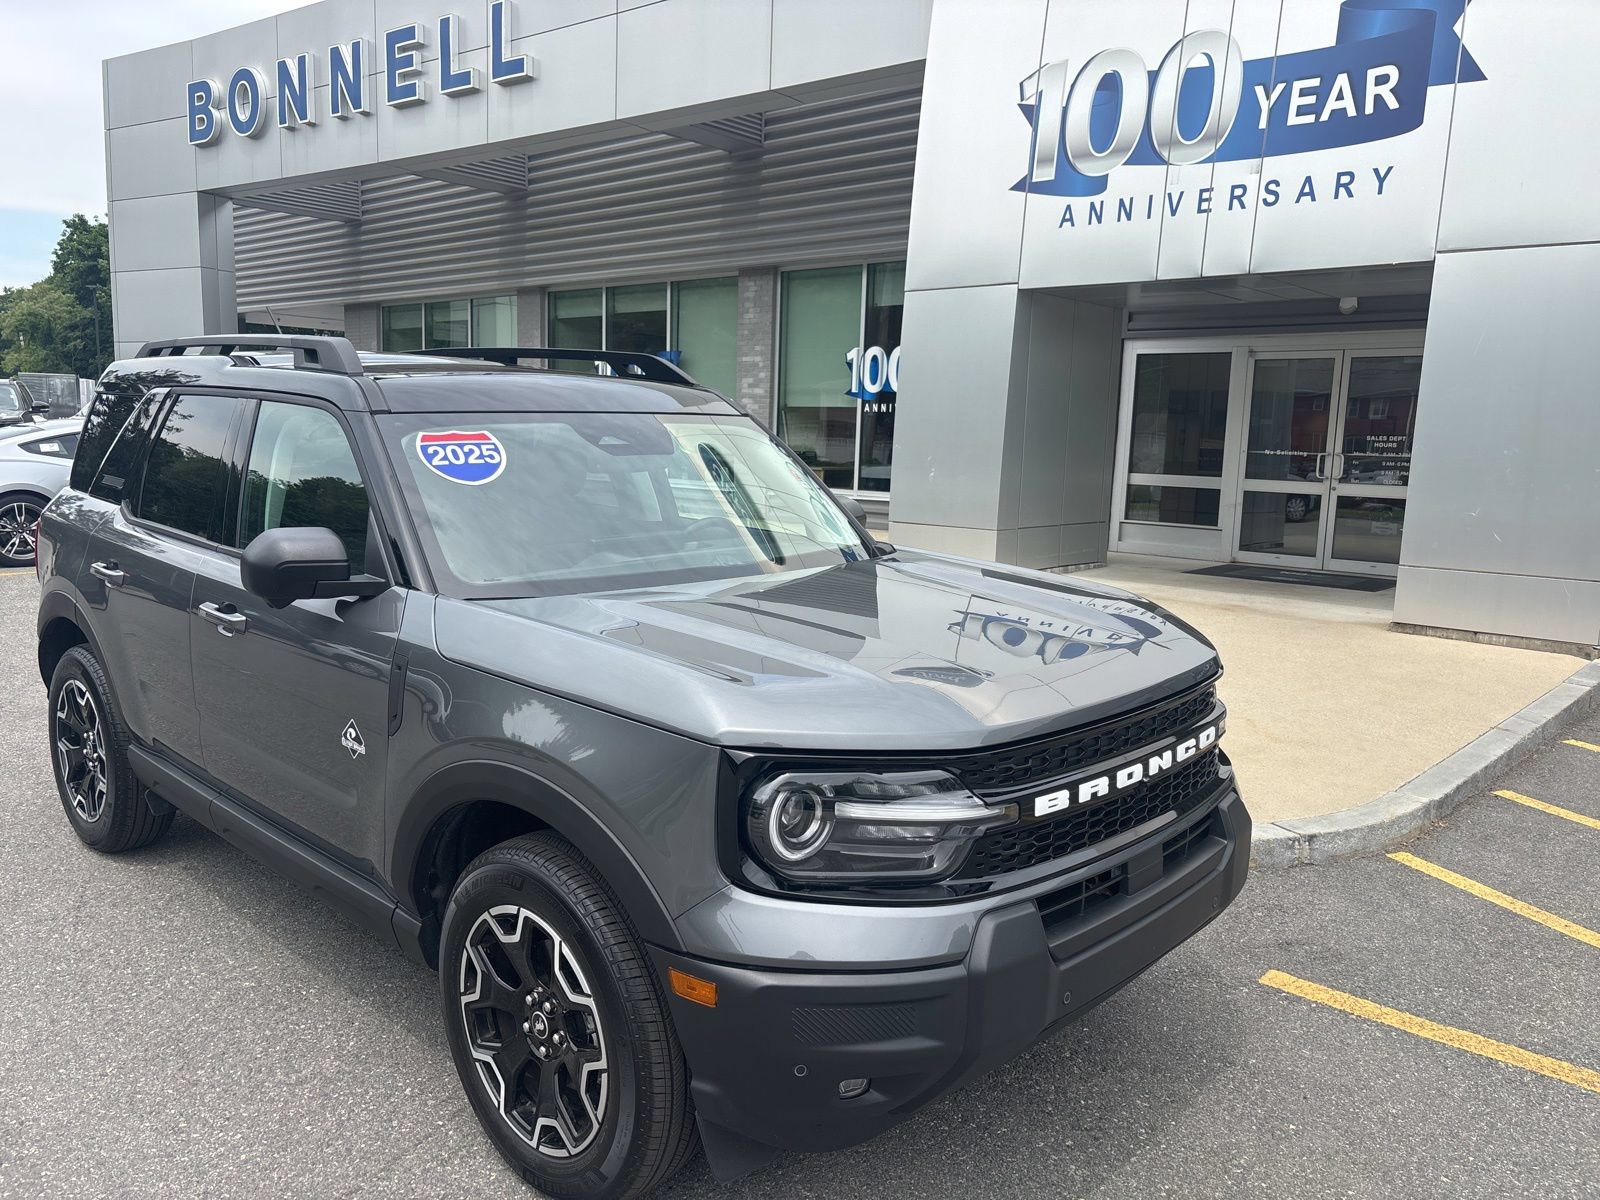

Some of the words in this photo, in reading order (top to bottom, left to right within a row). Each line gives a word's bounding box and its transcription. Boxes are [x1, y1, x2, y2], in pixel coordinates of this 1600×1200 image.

[186, 0, 533, 146] BONNELL
[1018, 27, 1243, 182] 100
[1252, 64, 1400, 130] YEAR
[1058, 165, 1394, 228] ANNIVERSARY
[427, 445, 501, 466] 2025
[1034, 726, 1217, 817] BRONCO
